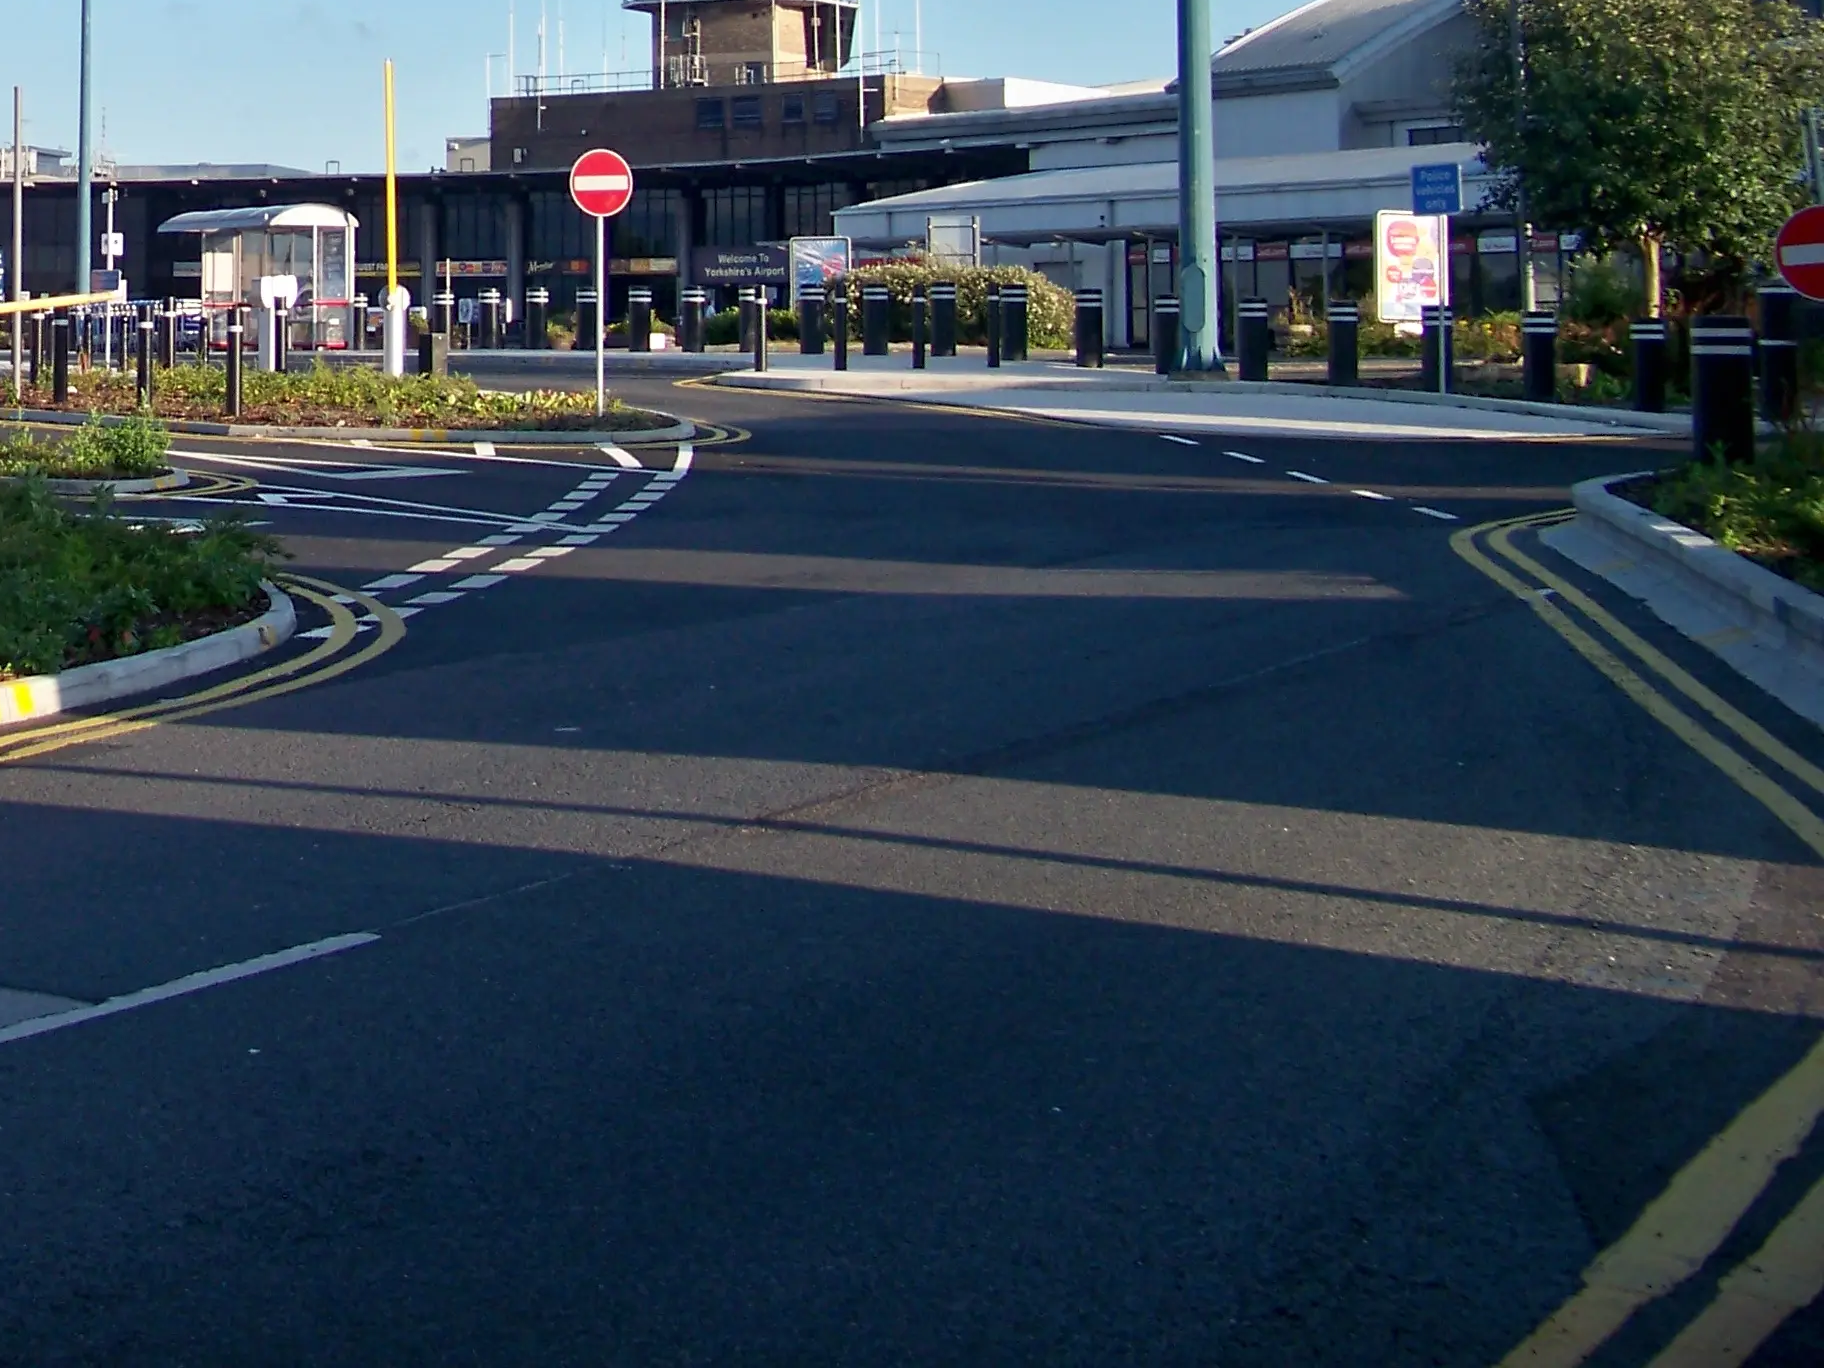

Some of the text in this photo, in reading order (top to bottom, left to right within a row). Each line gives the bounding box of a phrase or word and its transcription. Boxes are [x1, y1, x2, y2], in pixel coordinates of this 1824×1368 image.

[717, 253, 771, 264] Welcome To
[704, 266, 785, 278] Yorkshire's Airport
